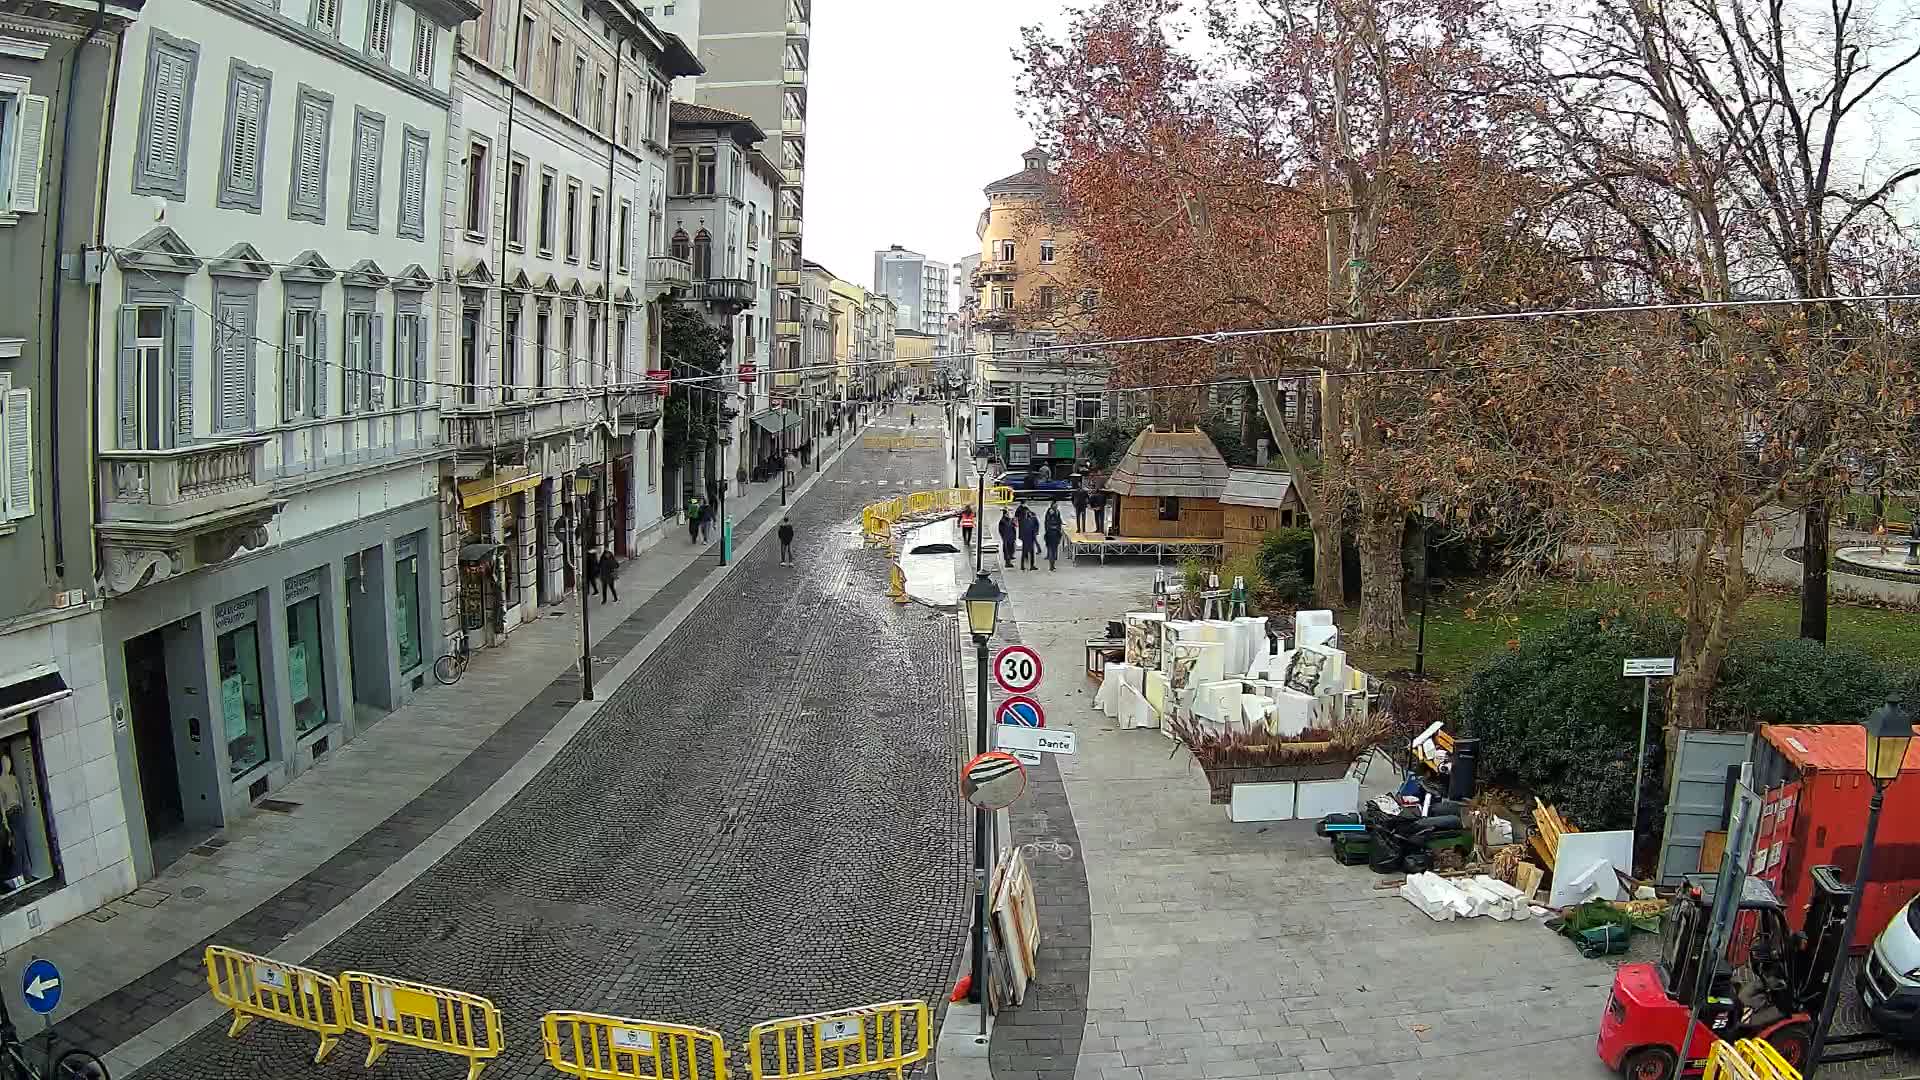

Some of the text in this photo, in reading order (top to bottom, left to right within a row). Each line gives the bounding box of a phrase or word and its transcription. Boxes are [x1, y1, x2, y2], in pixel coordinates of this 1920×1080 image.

[1005, 658, 1033, 680] 30
[1038, 738, 1070, 750] Dante
[1712, 1018, 1729, 1029] 25
